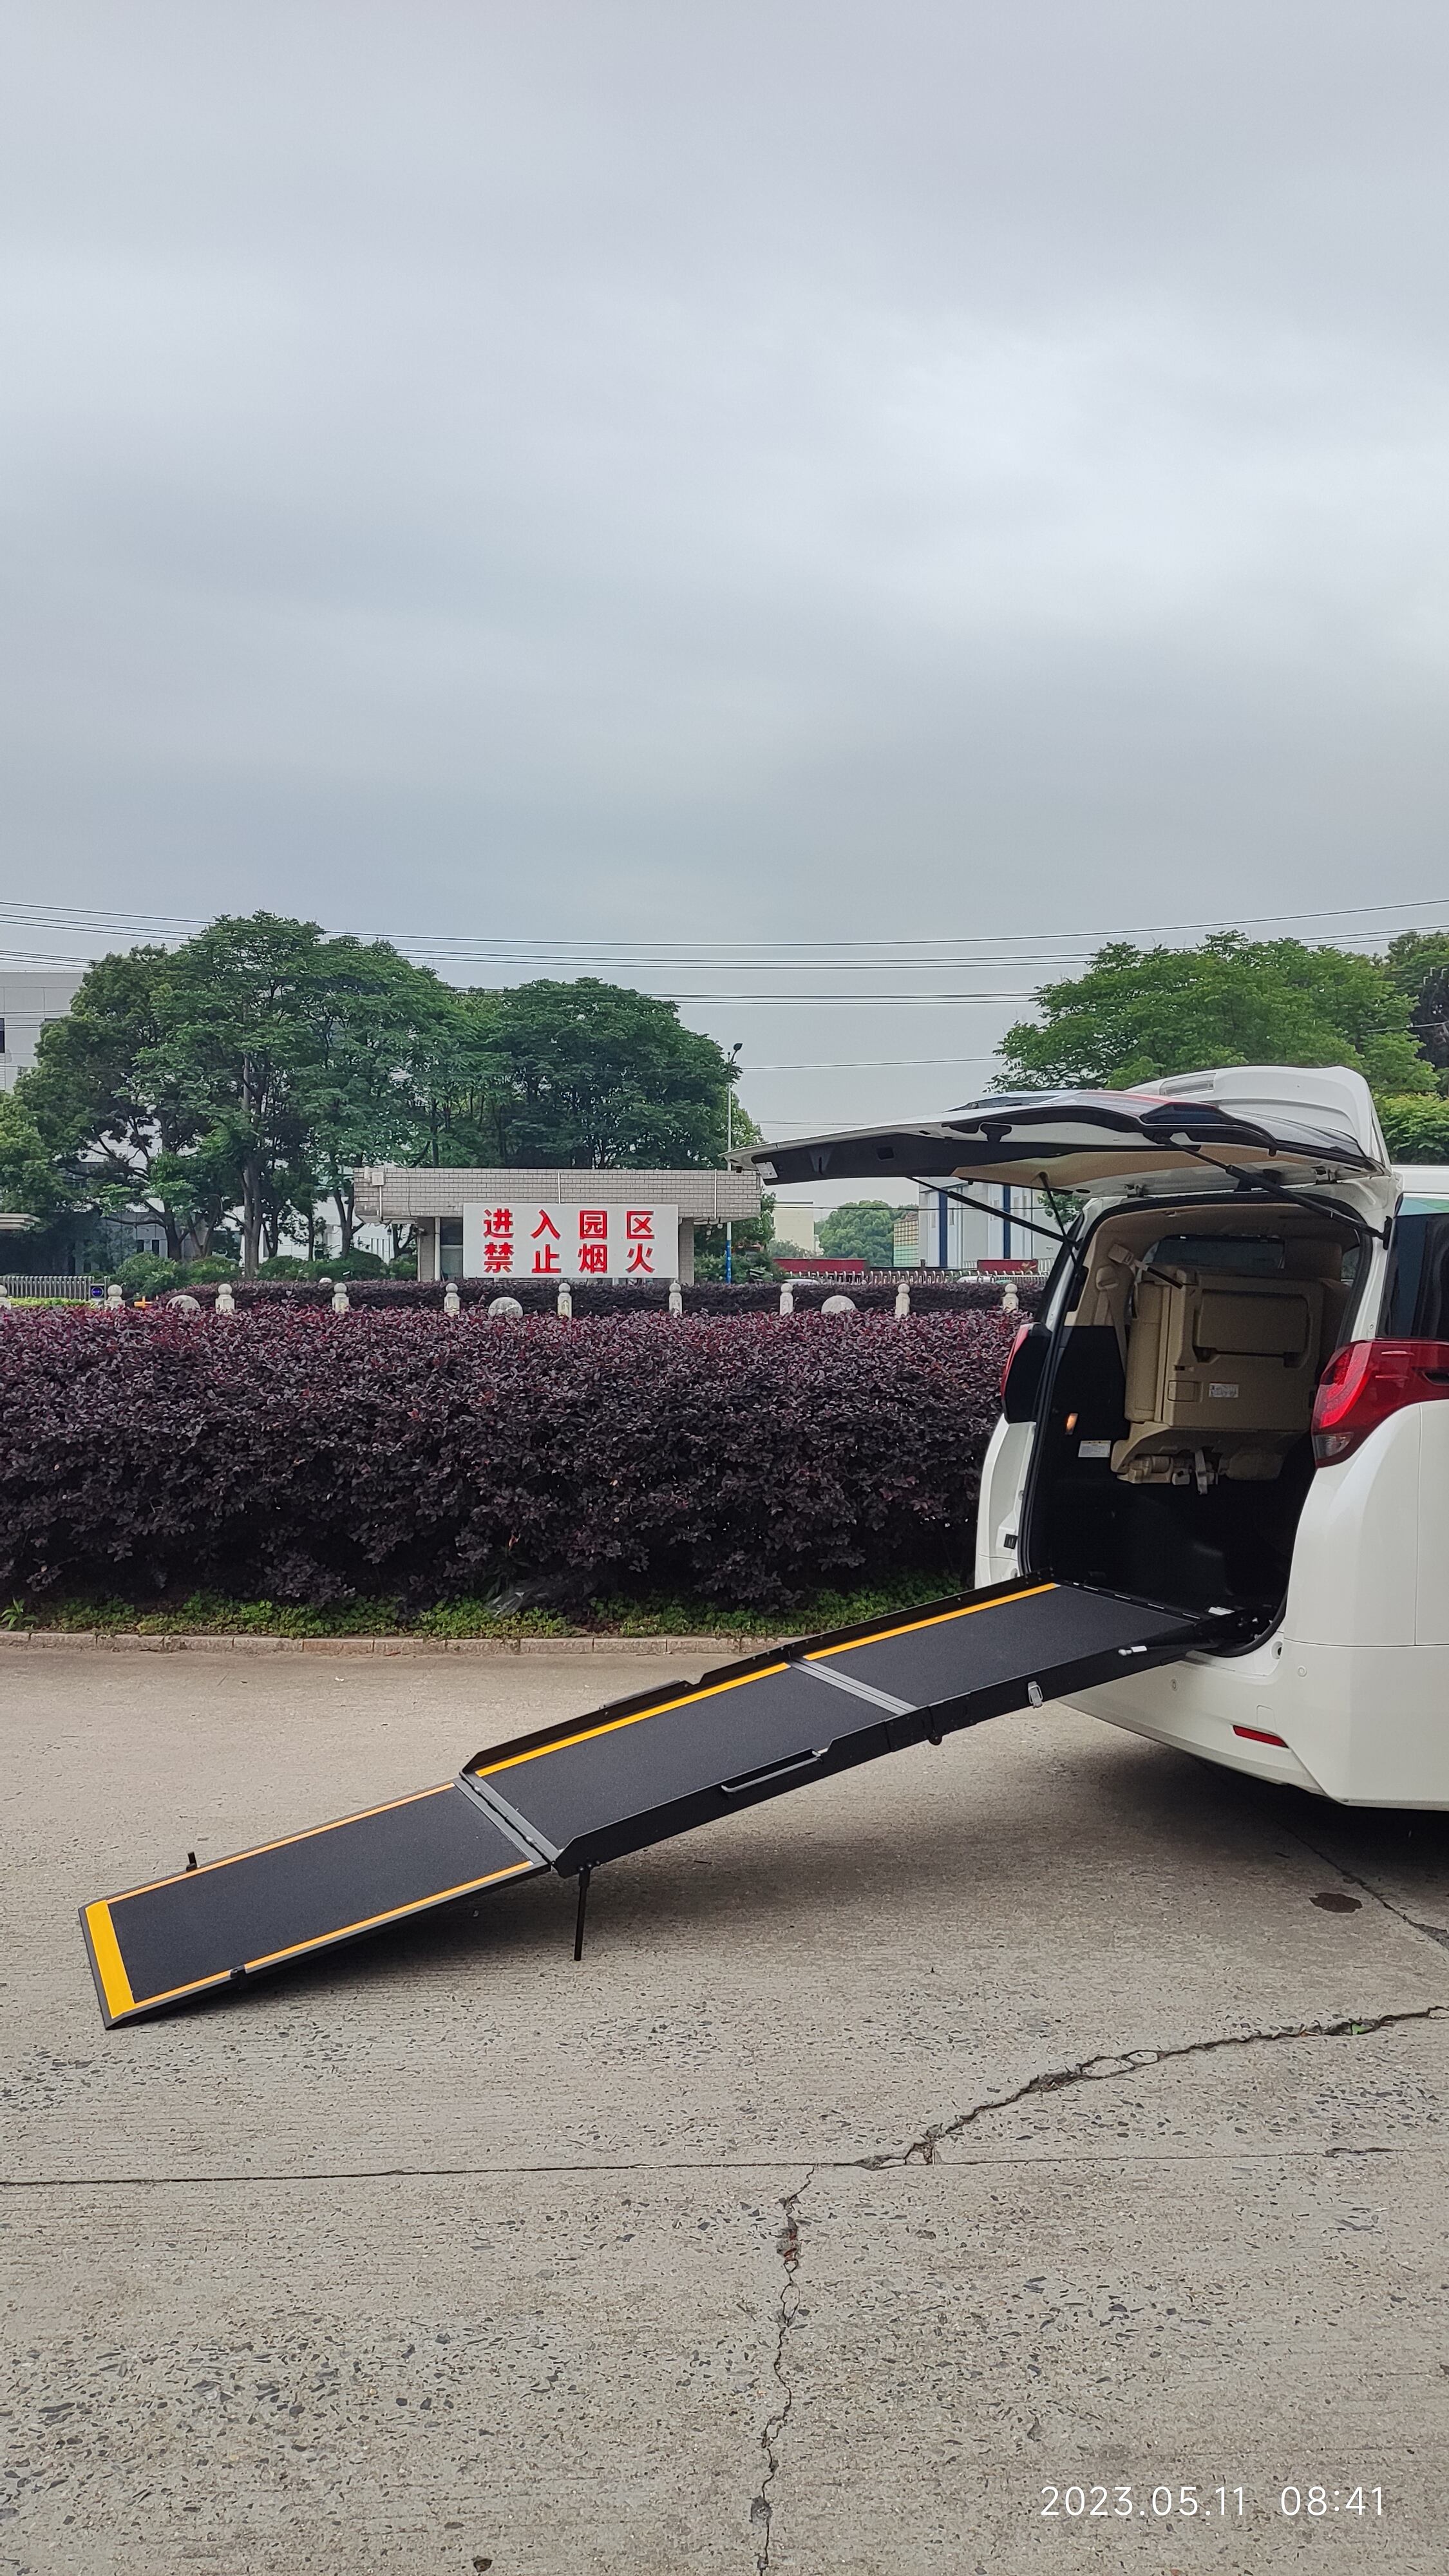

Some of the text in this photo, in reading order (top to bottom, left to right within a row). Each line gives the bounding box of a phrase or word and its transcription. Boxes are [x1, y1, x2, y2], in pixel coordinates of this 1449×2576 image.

[484, 1208, 655, 1240] 进入园区
[484, 1242, 655, 1274] 禁止烟火
